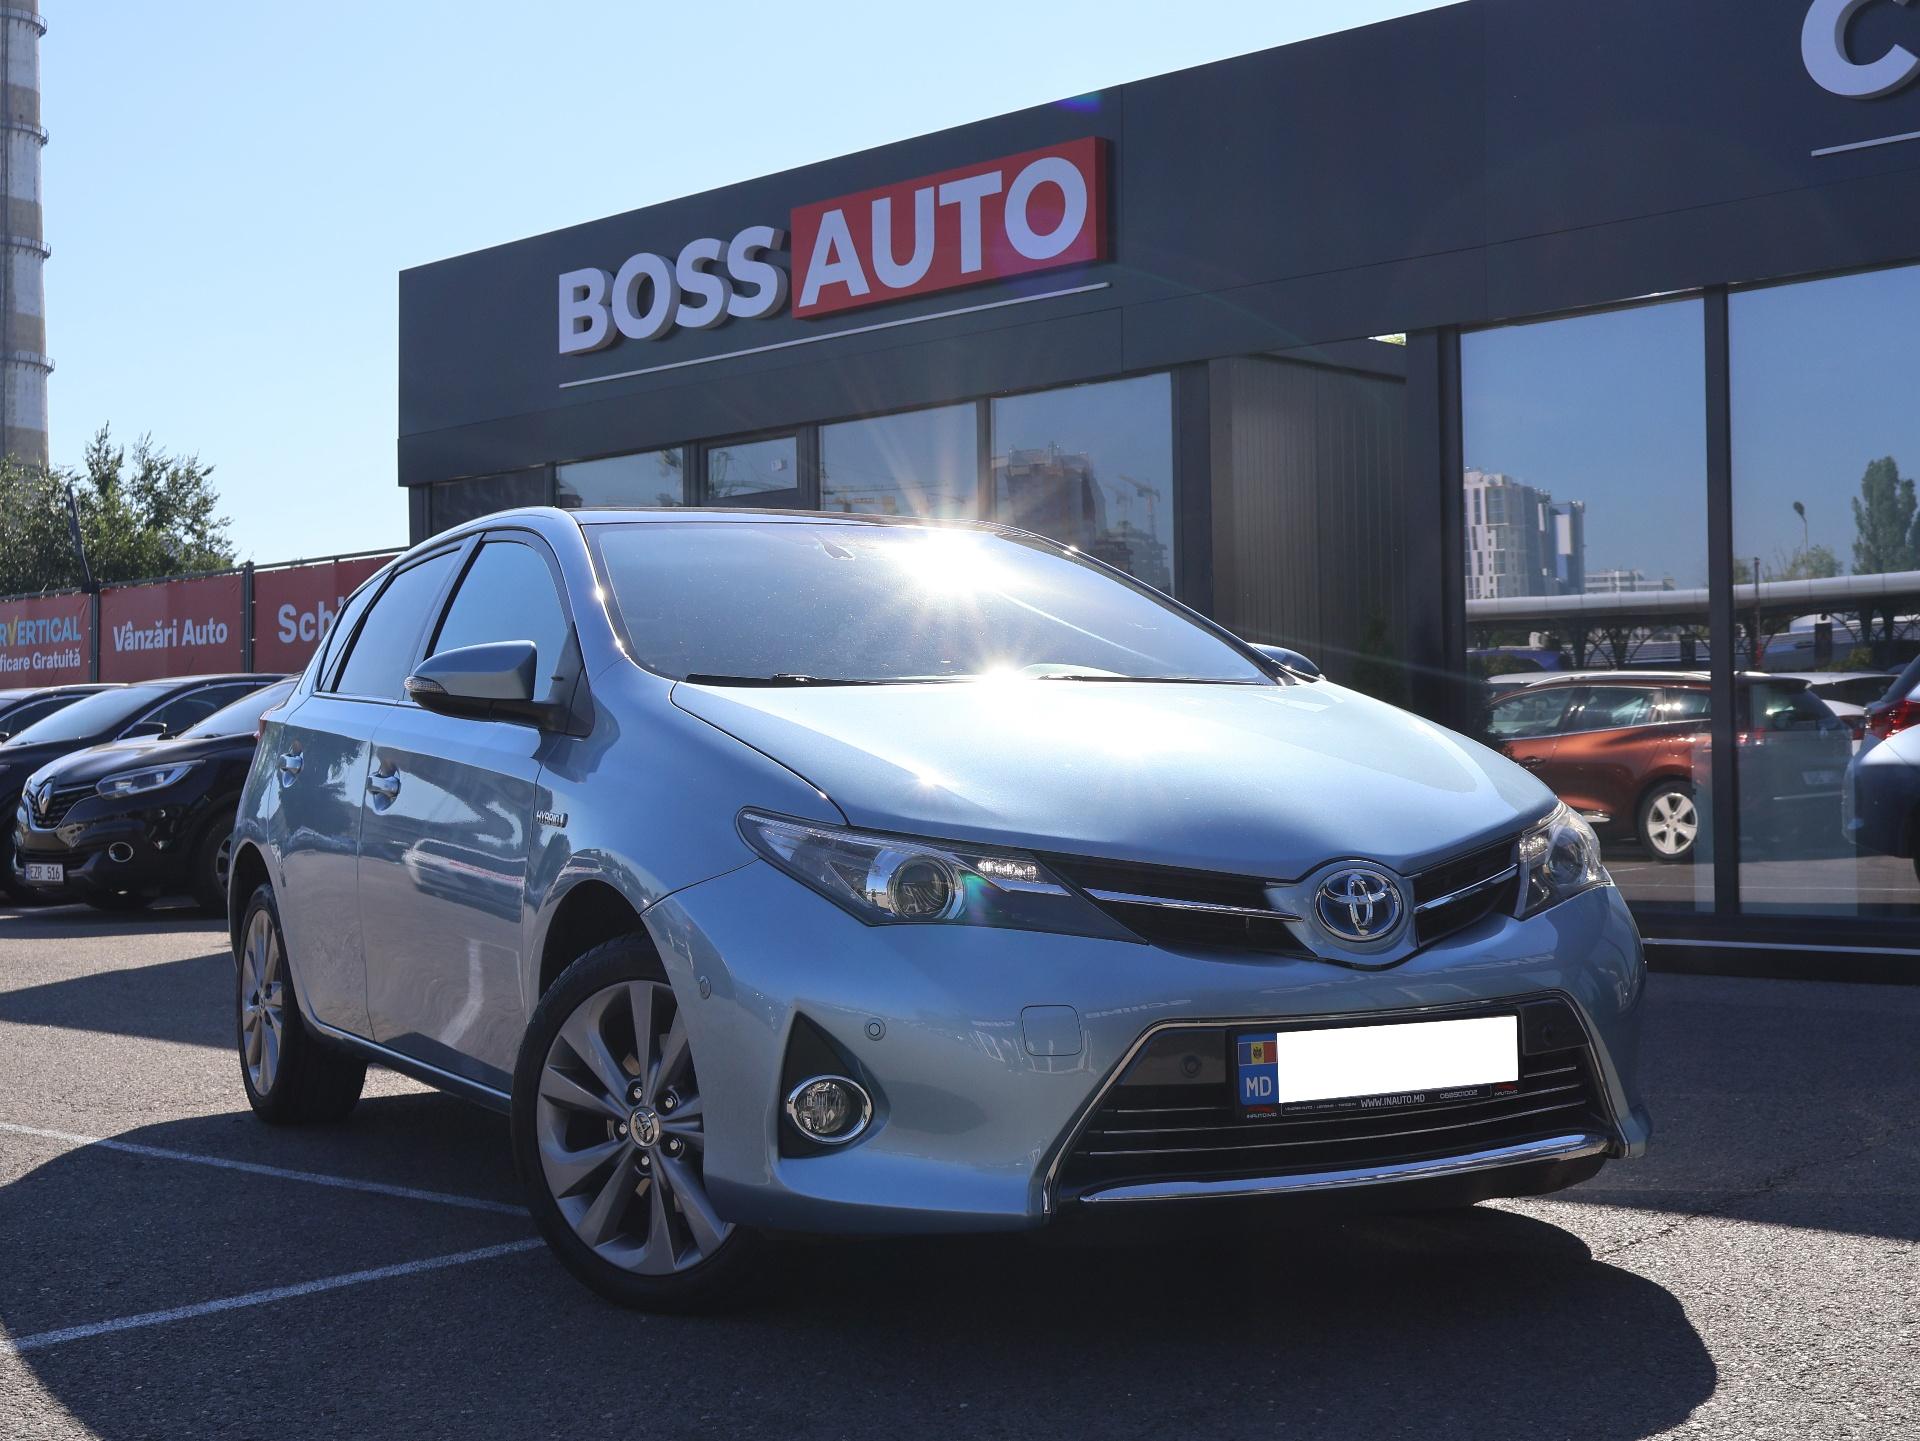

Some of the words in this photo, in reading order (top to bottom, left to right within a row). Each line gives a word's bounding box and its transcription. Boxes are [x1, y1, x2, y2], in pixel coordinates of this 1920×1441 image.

[558, 225, 788, 354] BOSS
[798, 156, 1088, 308] AUTO
[112, 619, 178, 652] Vânzări
[181, 616, 228, 646] Auto
[278, 596, 345, 644] Sch
[32, 647, 81, 670] Gratuită
[1246, 1076, 1272, 1098] MD
[1360, 1093, 1425, 1108] WWW.INAUTO.MD
